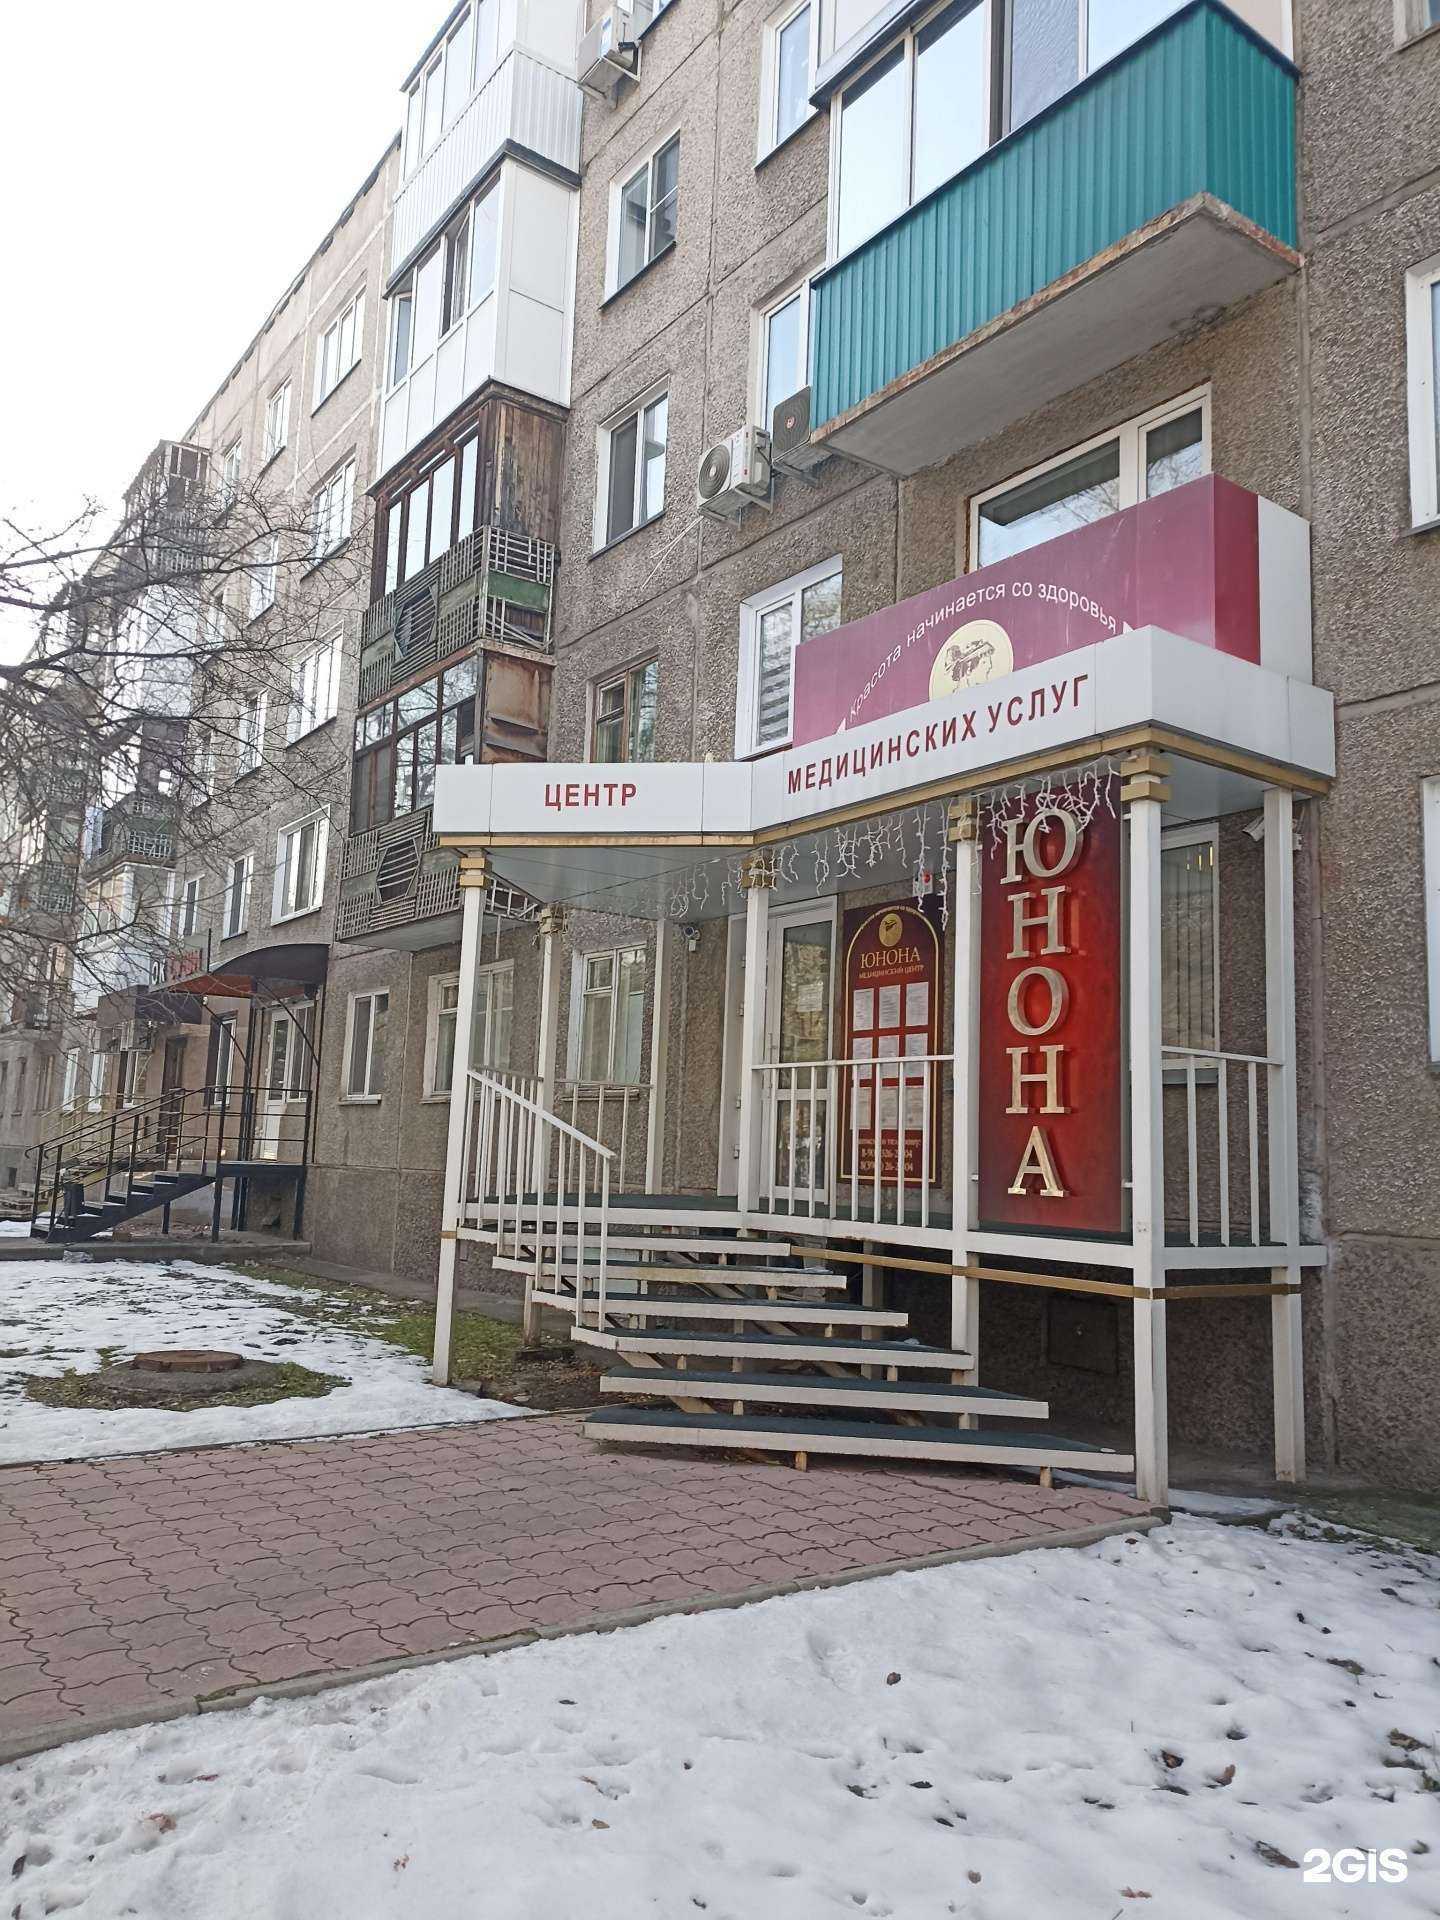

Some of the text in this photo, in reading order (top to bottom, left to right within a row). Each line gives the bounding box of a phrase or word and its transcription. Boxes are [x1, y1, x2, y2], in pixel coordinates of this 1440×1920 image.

[906, 583, 1006, 648] начинается
[1011, 582, 1033, 598] со
[1038, 583, 1117, 632] здоровья
[788, 674, 1089, 795] МЕДИЦИНСКИХ УСЛУГ
[544, 783, 637, 811] ЦЕНТР
[860, 946, 921, 969] ЮНОНА
[1000, 808, 1084, 1198] ЮНОНА
